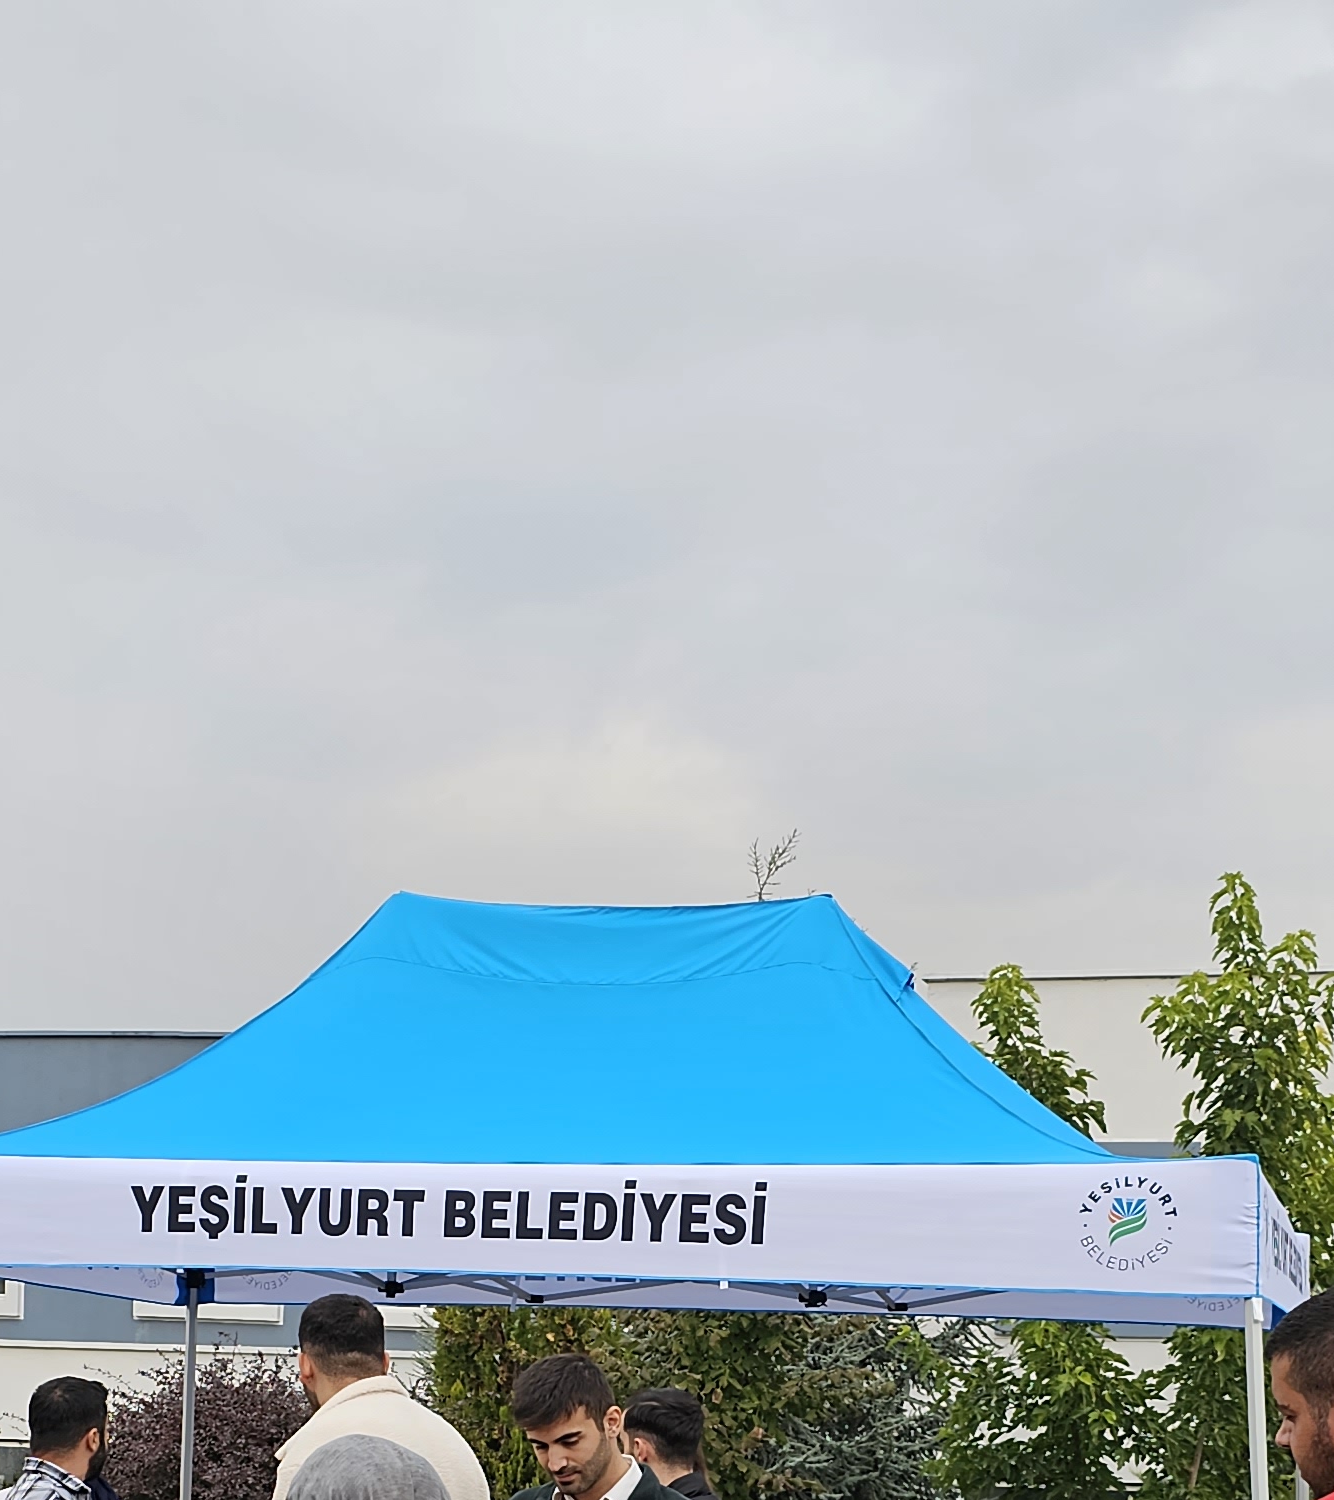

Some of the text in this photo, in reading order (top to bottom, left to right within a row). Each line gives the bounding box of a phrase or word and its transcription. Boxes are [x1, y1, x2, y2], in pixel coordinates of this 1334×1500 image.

[131, 1174, 769, 1245] YEŞİLYURT BELEDİYESİ
[1080, 1235, 1173, 1271] BELEDİYESİ
